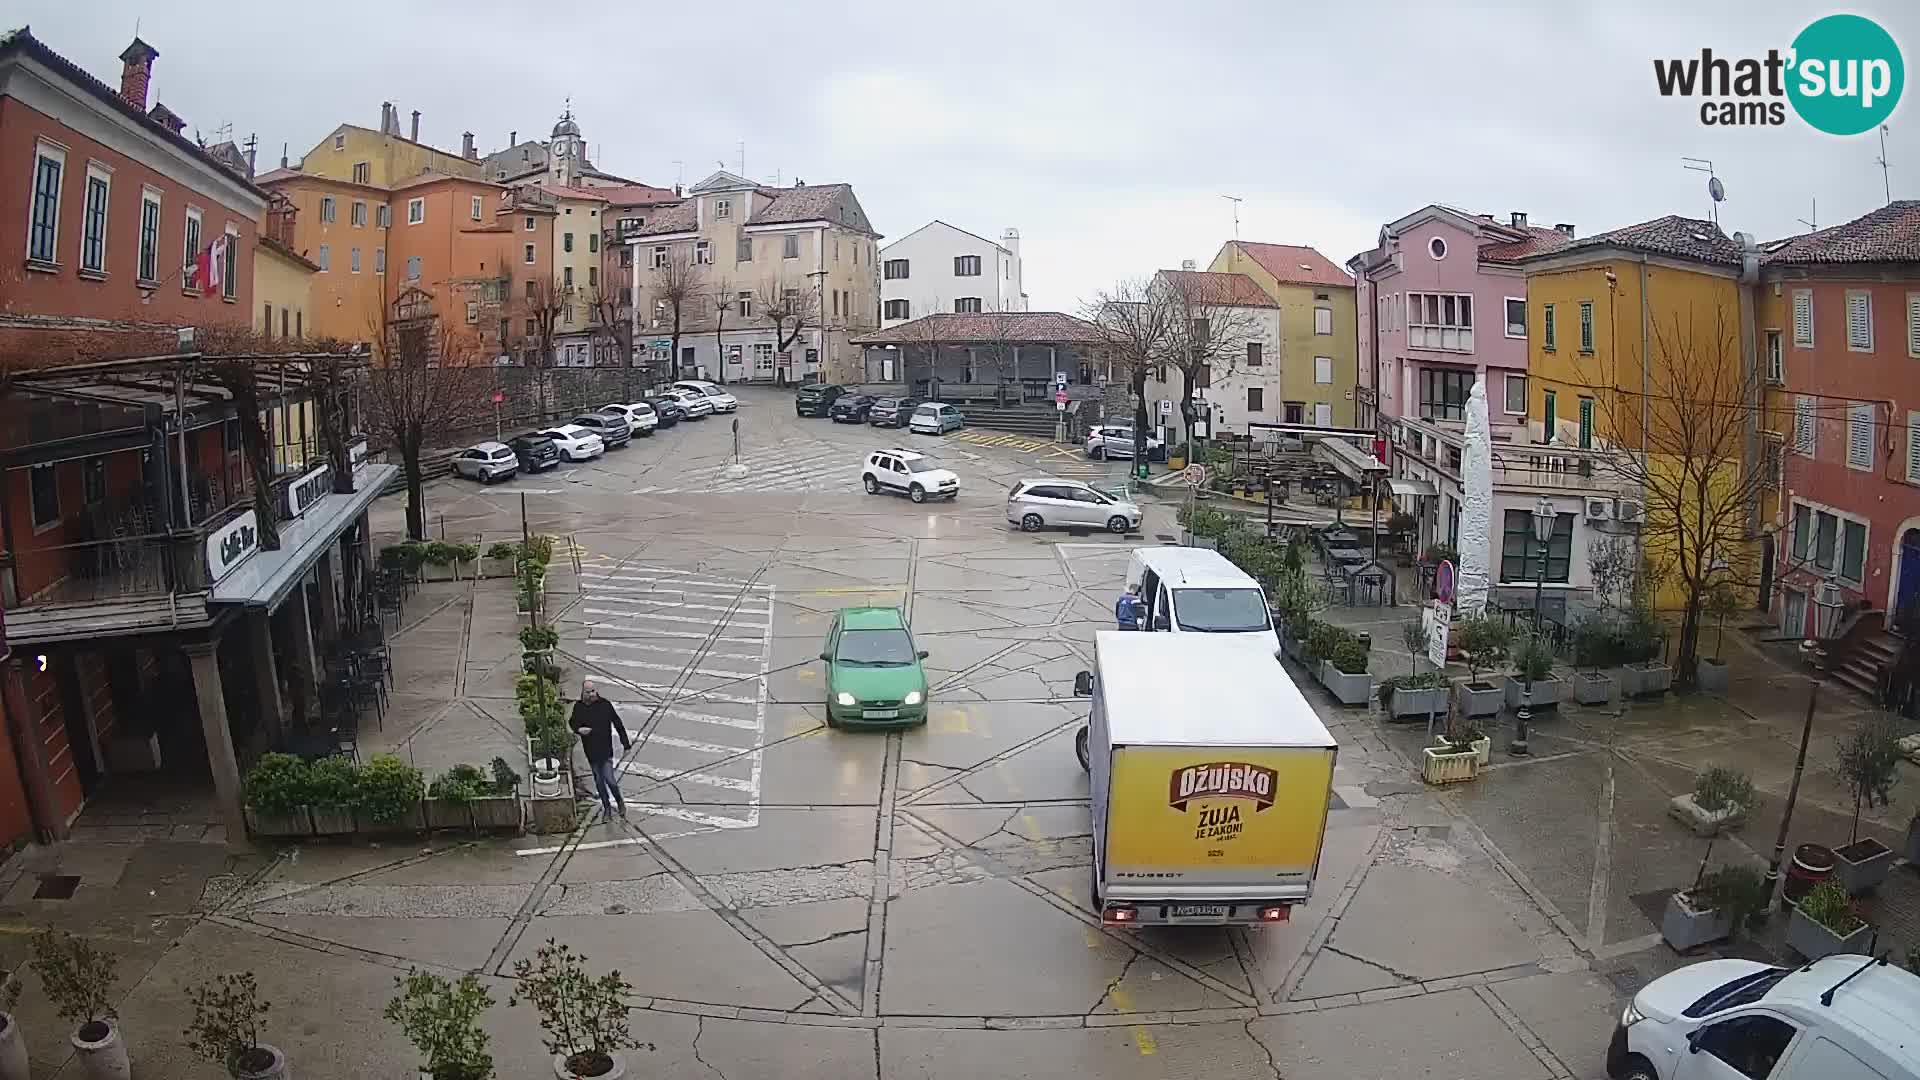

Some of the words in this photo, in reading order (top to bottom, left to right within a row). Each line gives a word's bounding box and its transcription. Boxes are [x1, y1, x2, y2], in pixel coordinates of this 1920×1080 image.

[1179, 763, 1271, 797] Ožujsko
[1197, 804, 1240, 828] ŽUJA
[1195, 828, 1206, 840] JE
